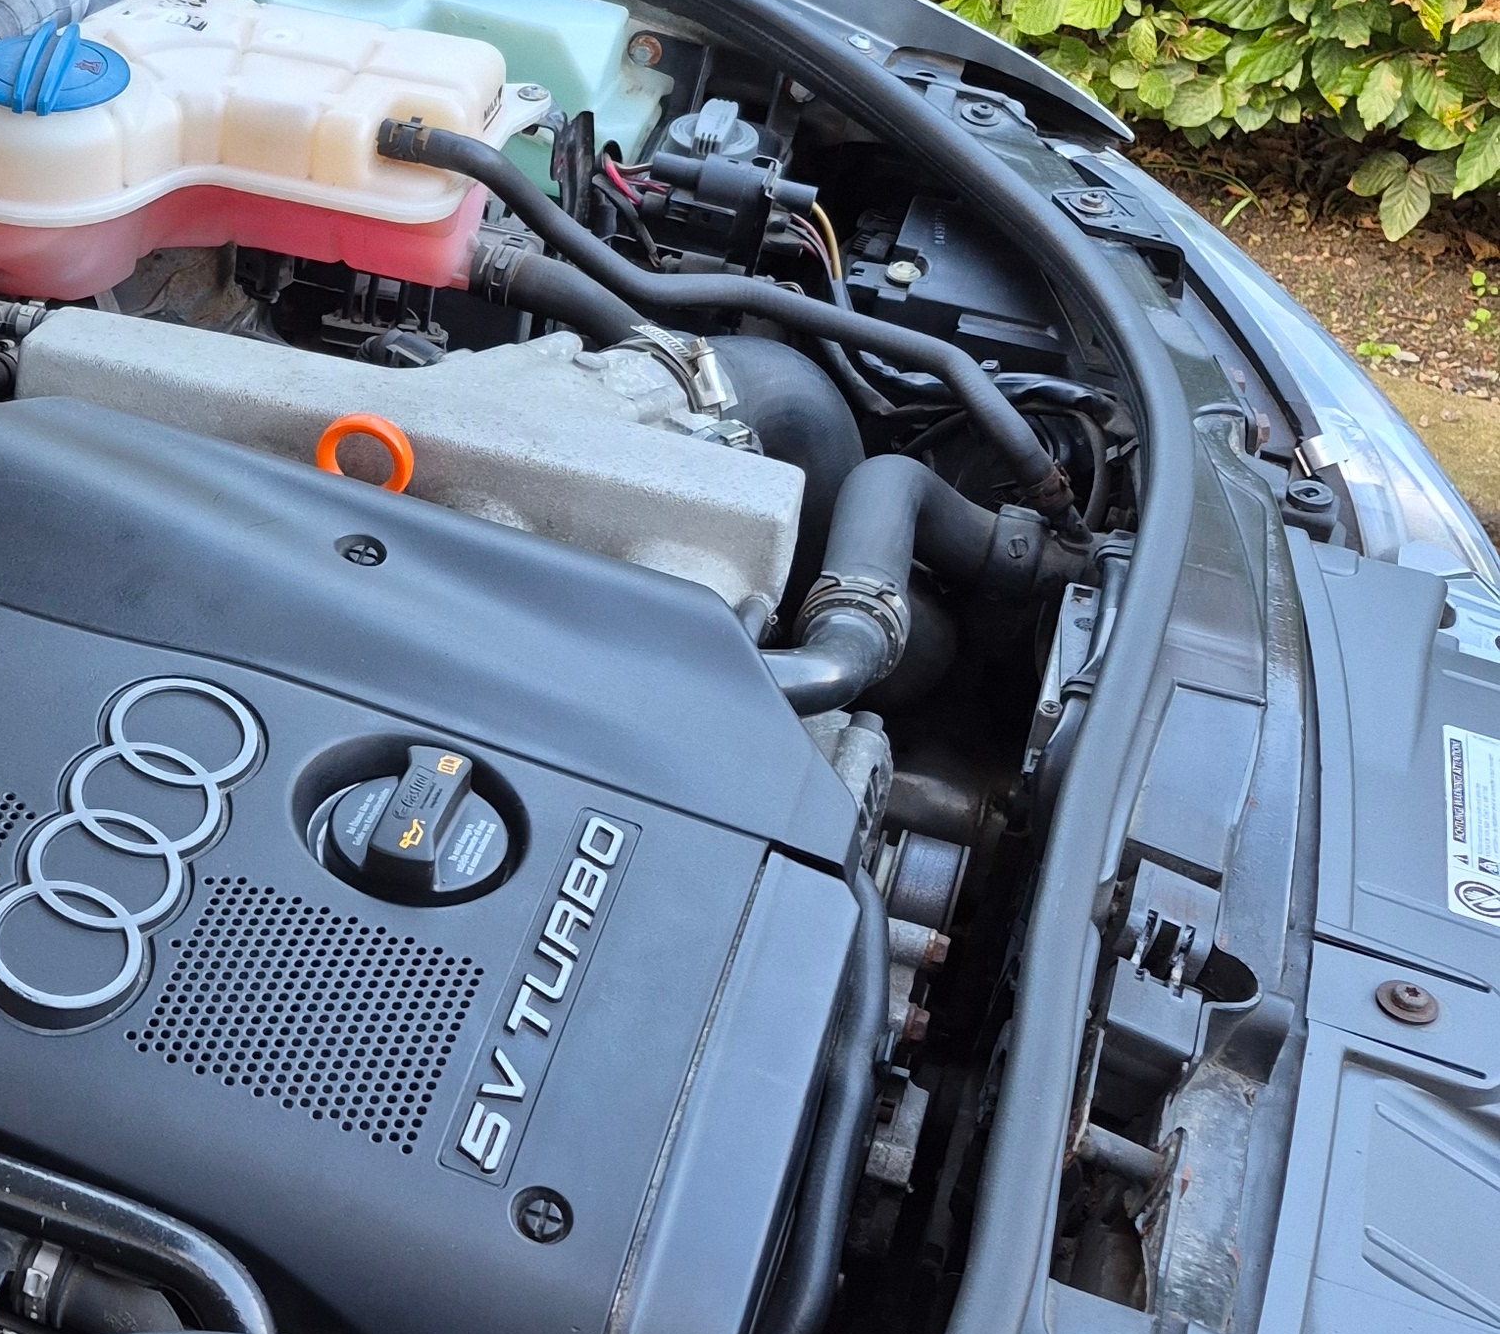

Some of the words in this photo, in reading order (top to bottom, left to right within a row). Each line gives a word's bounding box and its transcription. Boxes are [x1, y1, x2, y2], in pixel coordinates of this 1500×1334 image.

[401, 773, 429, 808] Castrol
[456, 1047, 527, 1175] 5V
[505, 816, 625, 1040] TURBO
